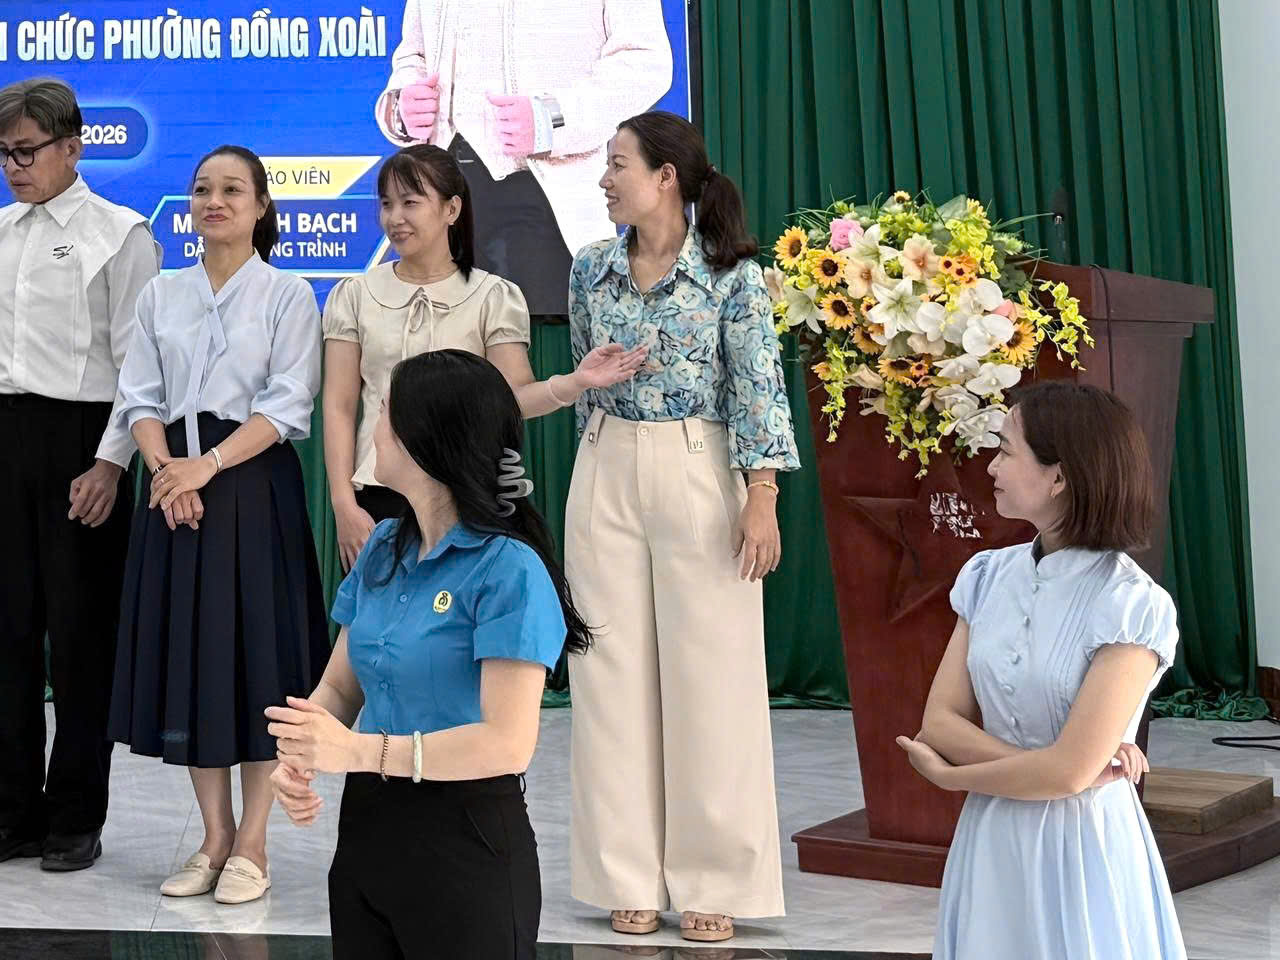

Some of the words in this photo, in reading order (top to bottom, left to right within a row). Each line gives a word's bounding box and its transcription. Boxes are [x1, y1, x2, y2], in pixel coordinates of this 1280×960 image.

[17, 12, 95, 61] CHỨC
[103, 8, 221, 60] PHƯỜNG
[230, 7, 309, 58] ĐỒNG
[318, 5, 387, 57] XOÀI
[266, 166, 287, 185] ÁO
[292, 166, 331, 185] VIÊN
[298, 213, 357, 238] BẠCH
[297, 237, 347, 257] TRÌNH
